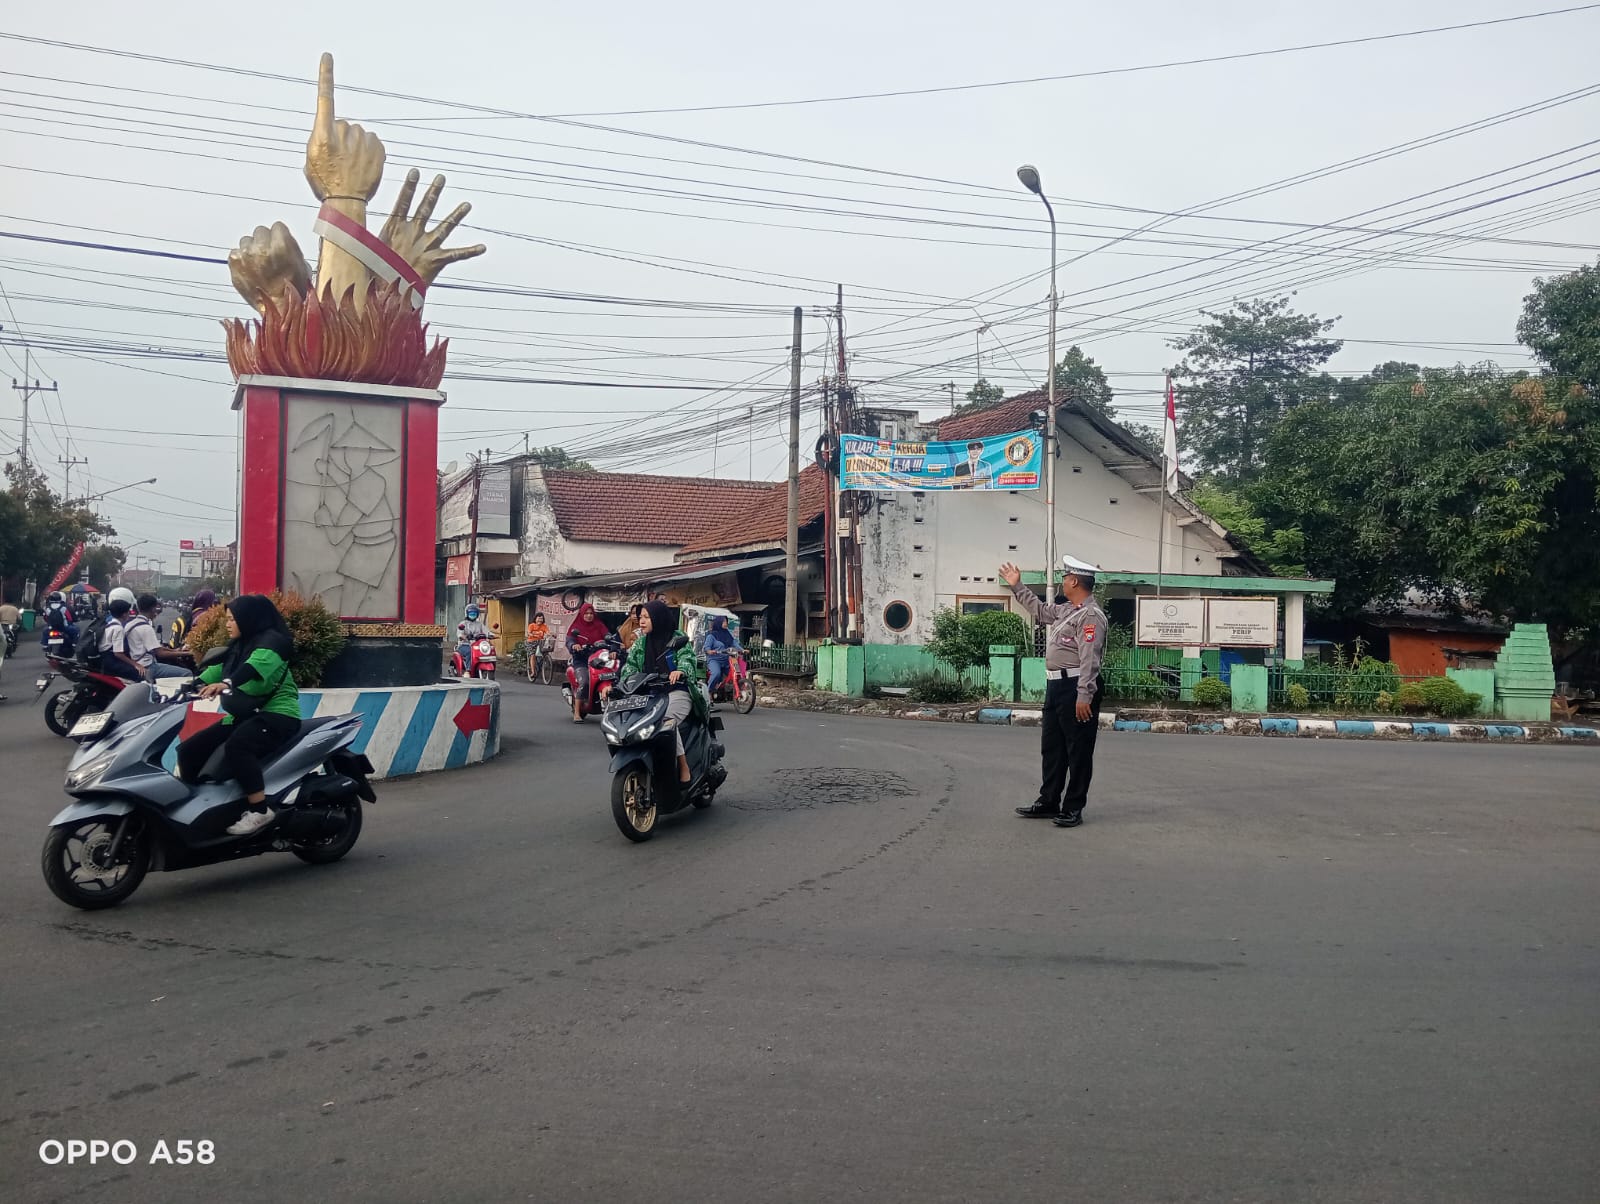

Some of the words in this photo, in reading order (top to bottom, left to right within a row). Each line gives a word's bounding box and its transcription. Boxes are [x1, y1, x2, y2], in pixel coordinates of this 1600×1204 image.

[845, 440, 874, 454] KULIAH
[895, 443, 926, 455] KERJA
[893, 458, 911, 472] AJA
